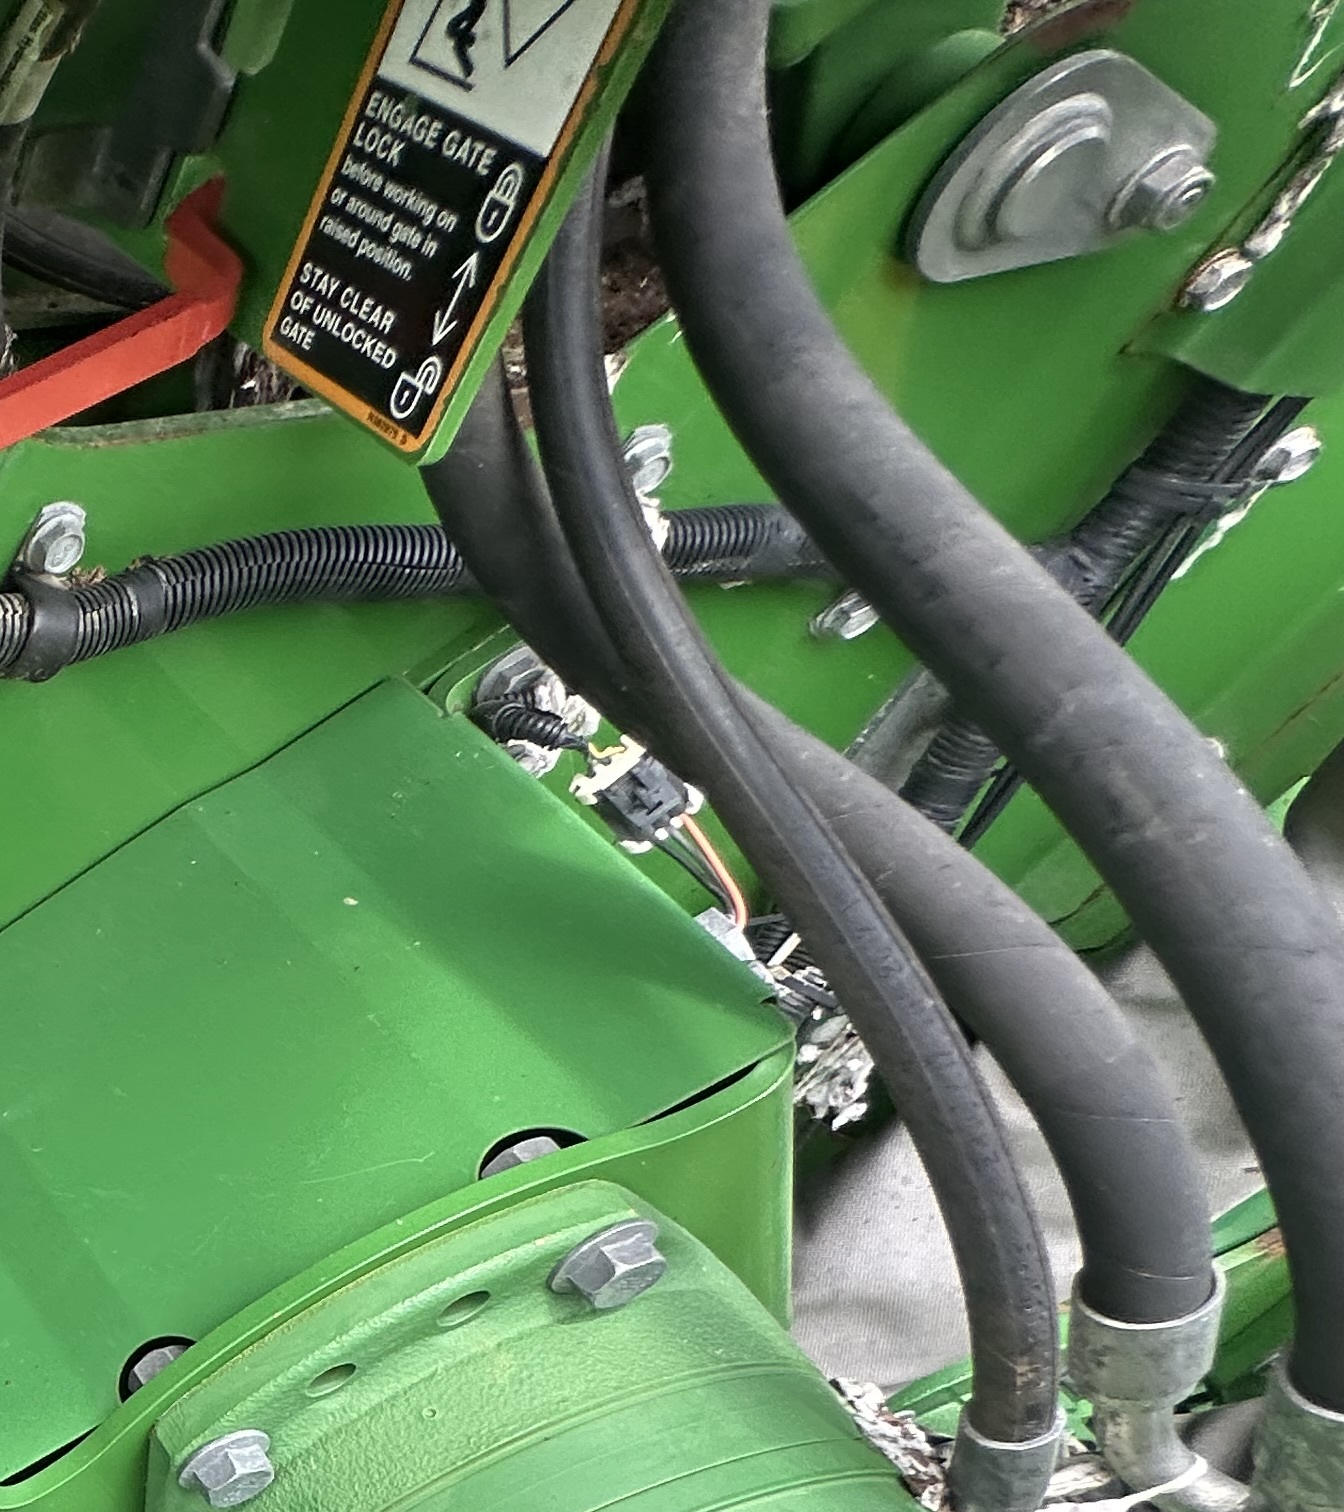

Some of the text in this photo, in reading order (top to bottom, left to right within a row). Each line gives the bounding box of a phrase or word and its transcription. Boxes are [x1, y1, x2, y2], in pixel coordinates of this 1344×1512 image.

[353, 121, 406, 167] LOCK
[365, 90, 497, 176] ENGAGE GATE
[330, 187, 439, 259] or around gate in
[341, 153, 460, 233] before working on
[318, 215, 361, 248] raised
[280, 315, 315, 350] GATE
[290, 290, 398, 369] OF UNLOCKED
[300, 262, 397, 335] STAY CLEAR
